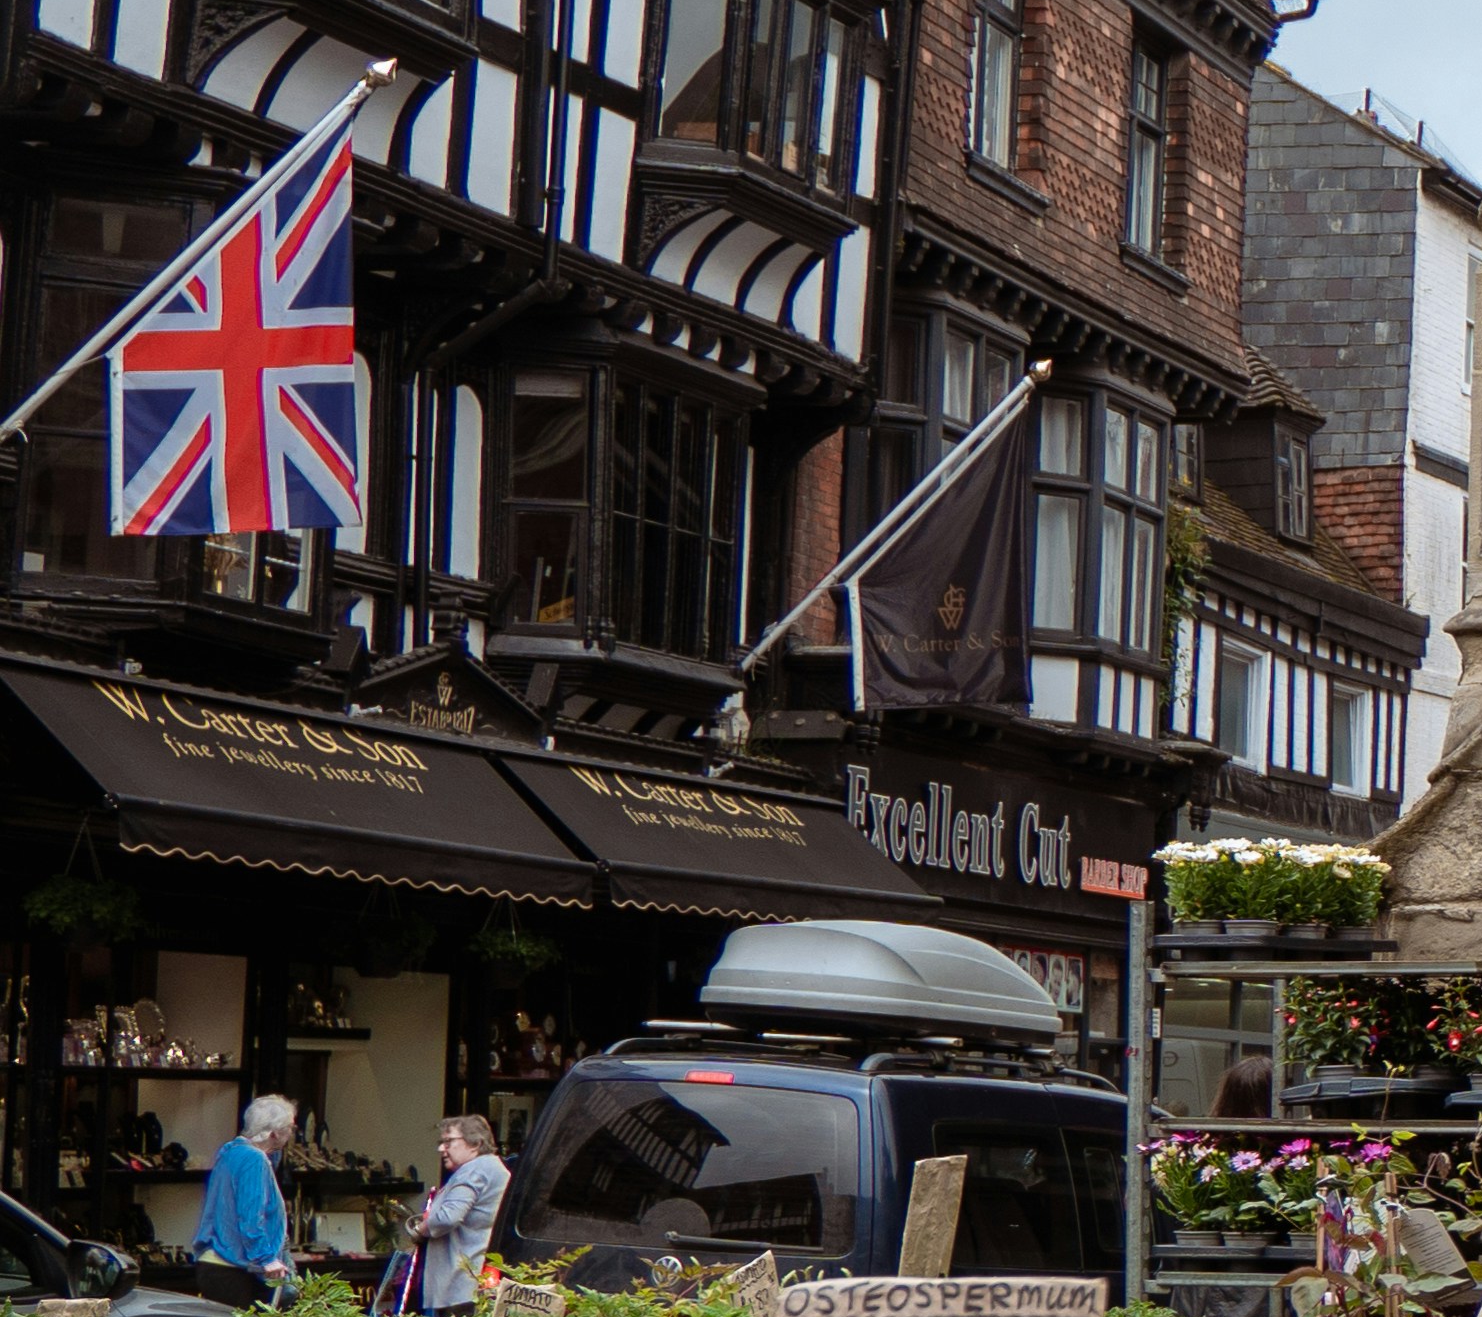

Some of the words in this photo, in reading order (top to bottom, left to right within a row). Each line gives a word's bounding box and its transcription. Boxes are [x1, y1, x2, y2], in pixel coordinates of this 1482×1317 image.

[904, 633, 961, 653] Carter
[966, 631, 985, 649] &
[990, 630, 1020, 649] Son
[93, 680, 165, 725] W.
[162, 693, 300, 749] Carter
[297, 718, 353, 755] &
[343, 727, 429, 771] Son
[162, 732, 215, 758] fine
[218, 741, 319, 781] jewellery
[321, 763, 376, 783] since
[375, 768, 425, 794] 1817
[568, 764, 622, 799] W.
[614, 773, 713, 813] Carter
[708, 789, 751, 815] &
[739, 794, 806, 826] Son
[621, 803, 662, 826] fine
[659, 809, 733, 839] jewellery
[733, 823, 773, 839] since
[771, 825, 807, 847] 1817
[846, 763, 1006, 879] Excellent
[1018, 802, 1072, 890] Cut
[1080, 855, 1121, 891] BARBER
[1120, 862, 1149, 894] SHOP
[783, 1281, 1099, 1317] OSTEOSPERMUM
